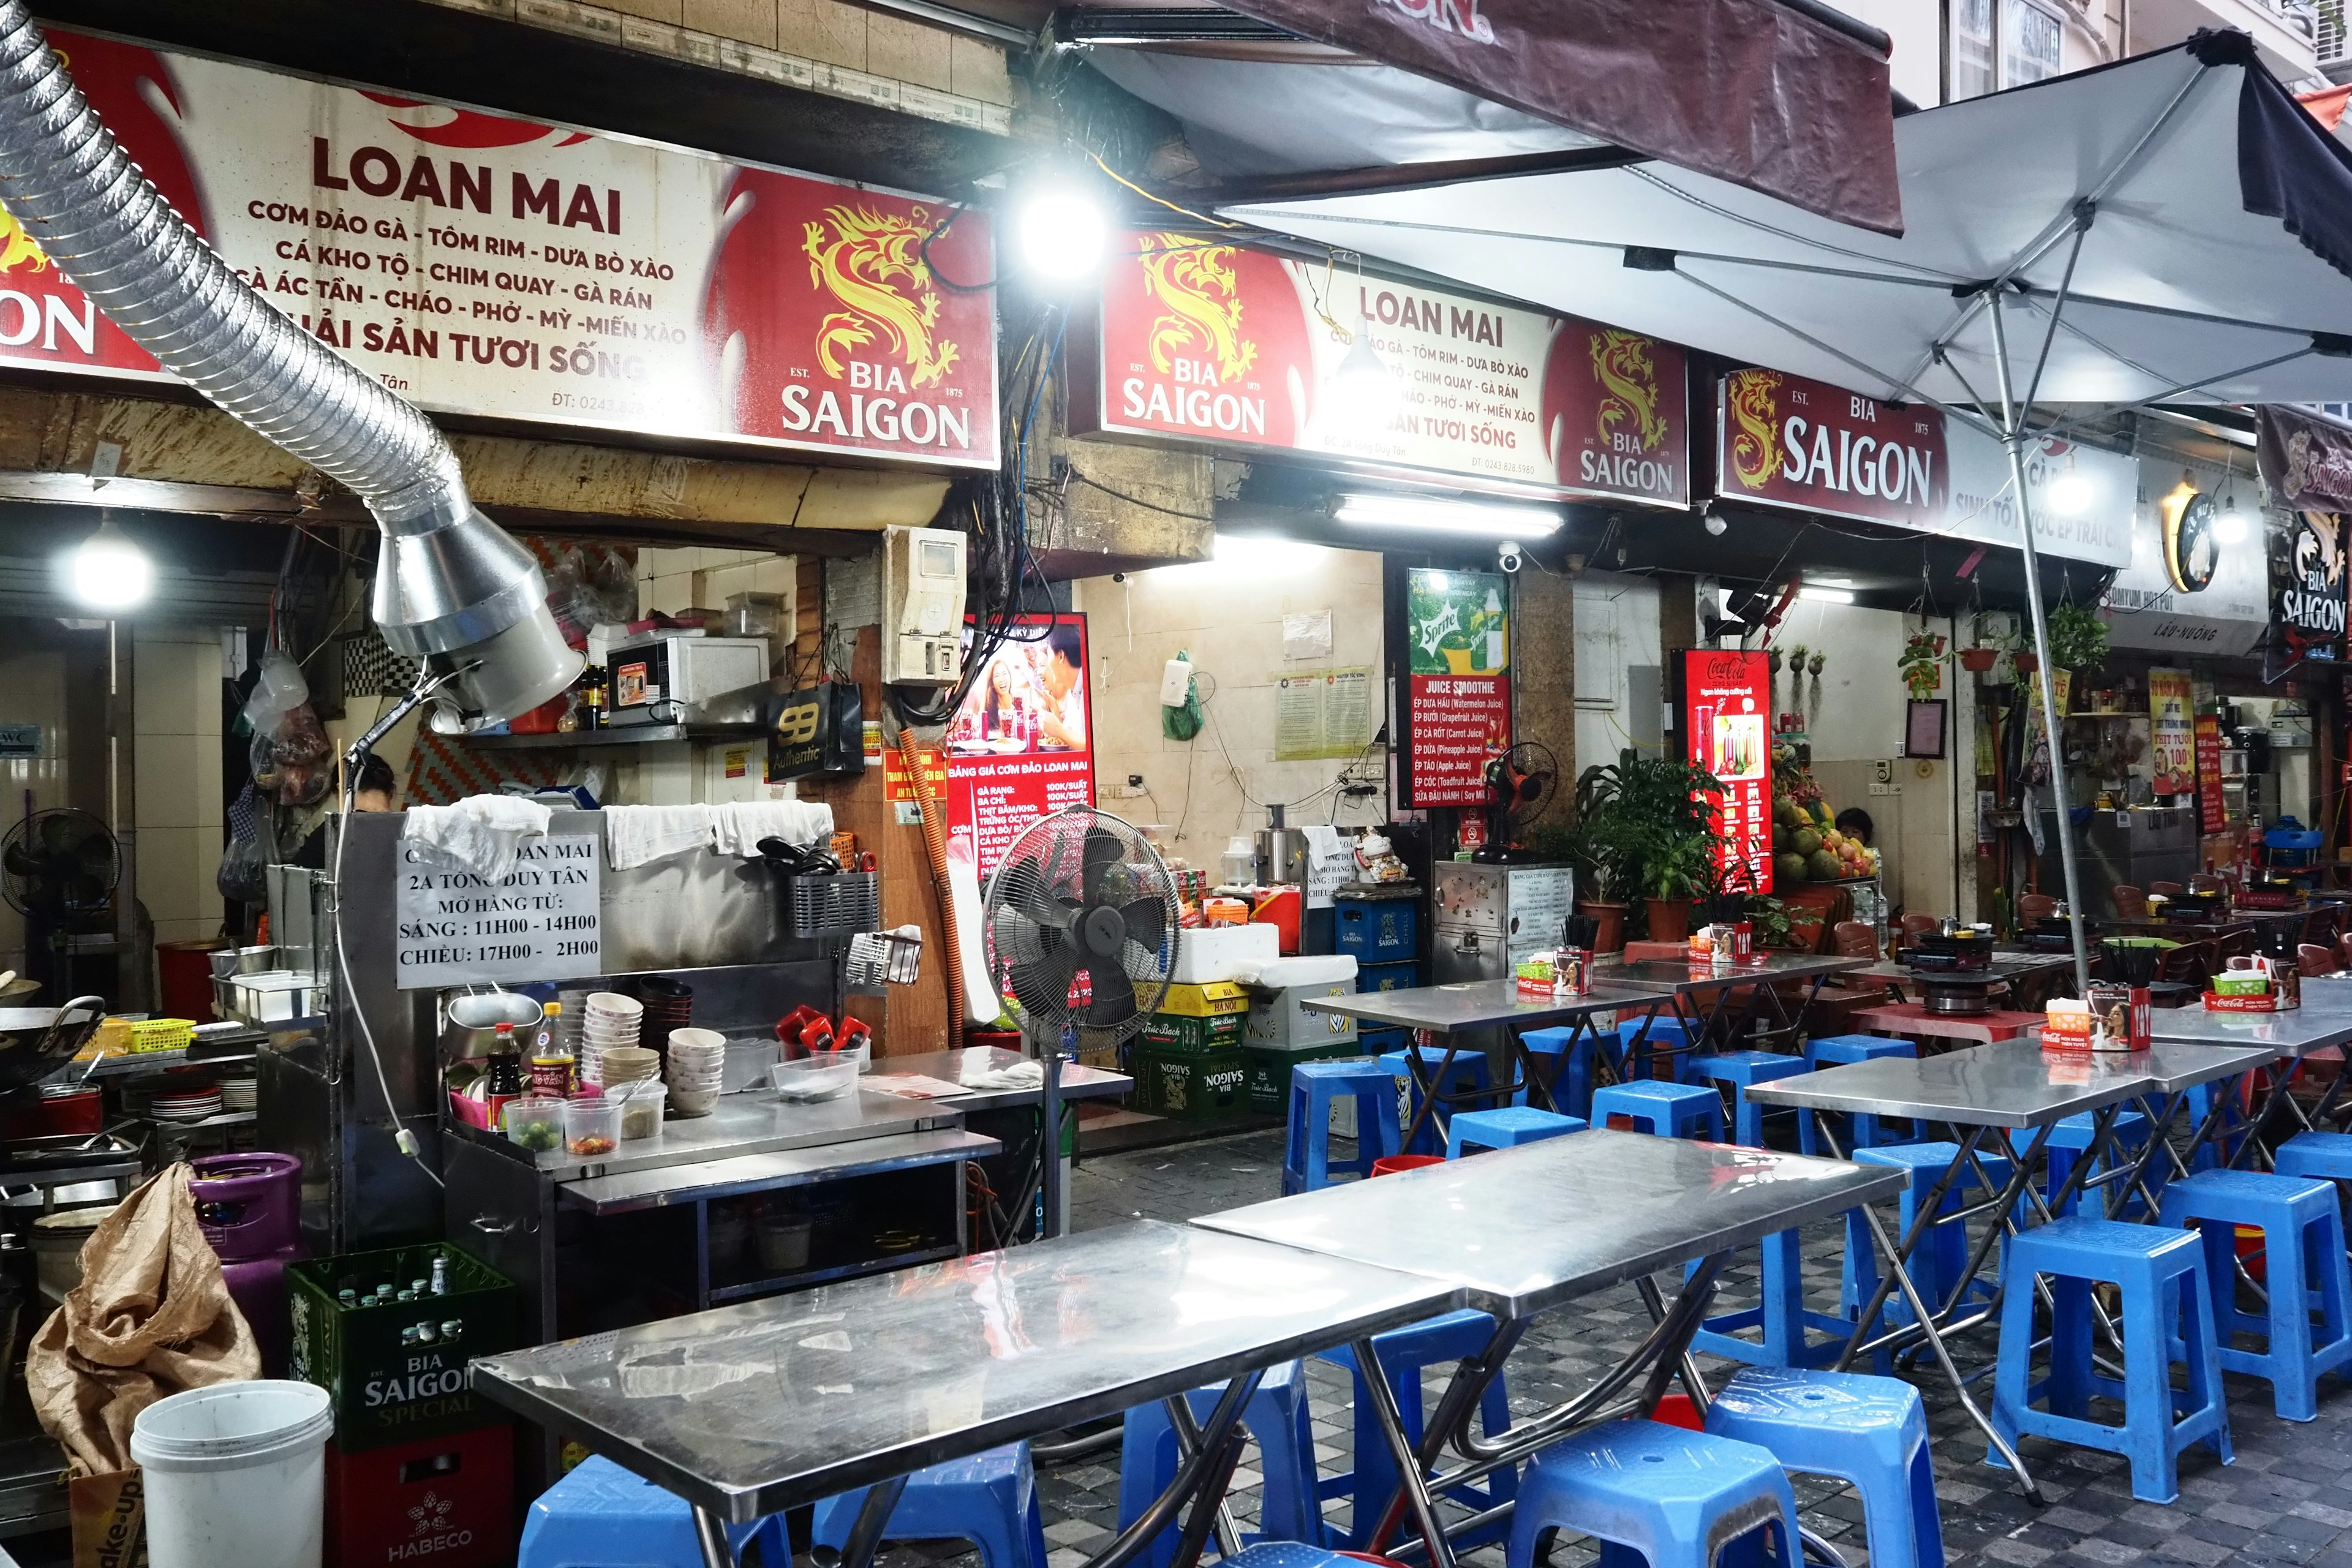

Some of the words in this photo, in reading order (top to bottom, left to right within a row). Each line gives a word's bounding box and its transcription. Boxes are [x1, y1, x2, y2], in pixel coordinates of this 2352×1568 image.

[314, 137, 492, 214] LOAN
[512, 173, 621, 235] MAI
[248, 200, 308, 226] CƠM
[315, 208, 367, 235] ĐẢO
[374, 216, 407, 241] GÀ
[428, 227, 478, 251] TÔM
[485, 238, 525, 258] RIM
[545, 246, 589, 268] DƯA
[595, 250, 624, 274] BÒ
[630, 257, 674, 281] XÀO
[276, 240, 311, 262] CÁ
[318, 246, 371, 270] KHO
[377, 252, 409, 282] TỘ
[430, 263, 488, 288] CHIM
[497, 272, 554, 296] QUAY
[574, 277, 605, 303] GÀ
[611, 284, 652, 311] RÁN
[274, 270, 309, 296] ÁC
[315, 277, 363, 303] TẦN
[385, 284, 453, 316] CHÁO
[472, 301, 521, 325] PHỞ
[540, 307, 571, 330] MỲ
[643, 322, 687, 345] XÀO
[1360, 286, 1441, 335] LOAN
[1451, 306, 1503, 348] MAI
[363, 317, 439, 360] SẢN
[449, 332, 539, 371] TƯƠI
[1388, 339, 1403, 355] GÀ
[1413, 344, 1436, 361] TÔM
[1439, 351, 1458, 365] RIM
[1467, 356, 1488, 371] DƯA
[1491, 359, 1505, 374] BÒ
[1507, 364, 1529, 379] XÀO
[790, 368, 810, 378] EST.
[850, 361, 907, 394] BIA
[946, 388, 962, 398] 1875
[1130, 363, 1145, 373] EST.
[1174, 358, 1218, 387] BIA
[1414, 370, 1441, 385] CHIM
[1444, 375, 1472, 391] QUAY
[1481, 381, 1496, 395] GÀ
[1498, 384, 1518, 399] RÁN
[782, 385, 970, 449] SAIGON
[1123, 378, 1265, 435] SAIGON
[1434, 394, 1457, 409] PHỞ
[1465, 400, 1480, 414] MỲ
[1514, 409, 1535, 423] XÀO
[1792, 391, 1808, 405] EST.
[1850, 396, 1876, 423] BIA
[1915, 422, 1929, 435] 1875
[1423, 416, 1466, 442] TƯƠI
[1471, 422, 1516, 449] SỐNG
[1614, 432, 1642, 455] BIA
[1485, 459, 1535, 475] 0243.828.5980
[1581, 450, 1673, 494] SAIGON
[1784, 415, 1932, 508] SAIGON
[1992, 496, 2013, 527] TỐ
[2308, 570, 2326, 592] BIA
[2144, 591, 2157, 609] HOT
[2160, 594, 2173, 611] POT
[2282, 589, 2346, 633] SAIGON
[1425, 614, 1455, 644] Sprite
[1426, 681, 1450, 693] JUICE
[1453, 681, 1495, 694] SMOOTHIE
[1414, 697, 1422, 707] ÉP
[1423, 699, 1436, 707] DƯA
[1438, 696, 1450, 707] HẤU
[1452, 699, 1486, 709] (Watermelon
[1487, 699, 1504, 709] Juice)
[1414, 710, 1422, 722] ÉP
[1440, 712, 1469, 723] (Grapefruit
[1471, 712, 1488, 723] Juice)
[1414, 726, 1422, 738] ÉP
[1423, 726, 1433, 737] CÀ
[1447, 728, 1466, 739] (Carrot
[1467, 729, 1484, 739] Juice)
[774, 744, 820, 770] Authentic
[1414, 744, 1422, 755] ÉP
[1438, 745, 1466, 756] (Pineapple
[1466, 745, 1482, 755] Juice)
[887, 772, 902, 782] THAM
[935, 771, 944, 781] GIA
[948, 764, 976, 778] BẢNG
[978, 763, 995, 777] GIÁ
[997, 764, 1020, 775] CƠM
[1022, 761, 1042, 774] ĐẢO
[1044, 763, 1069, 772] LOAN
[1071, 761, 1088, 771] MAI
[1415, 760, 1422, 771] ÉP
[1423, 760, 1435, 771] TÁO
[1436, 761, 1453, 772] (Apple
[1455, 761, 1471, 771] Juice)
[978, 786, 988, 796] GÀ
[989, 786, 1015, 795] RANG:
[1415, 775, 1422, 787] ÉP
[1424, 775, 1436, 786] CÓC
[1438, 777, 1464, 788] (Toadfruit
[1466, 777, 1482, 787] Juice)
[897, 788, 905, 798] AN
[1442, 790, 1460, 801] NÀNH
[1464, 791, 1474, 802] Soy
[978, 807, 997, 818] THỊT
[979, 816, 1006, 826] TRỨNG
[951, 825, 971, 834] CƠM
[979, 826, 997, 836] DƯA
[555, 844, 592, 859] MAI
[980, 837, 990, 846] CÁ
[992, 836, 1009, 845] KHO
[980, 847, 997, 856] TIM
[981, 856, 998, 865] TÔM
[1332, 864, 1349, 873] HÀNG
[410, 875, 433, 890] 2A
[504, 871, 544, 886] DUY
[549, 867, 588, 884] TÂN
[438, 895, 470, 914] MỞ
[475, 895, 527, 913] HÀNG
[532, 892, 564, 910] TỪ:
[400, 919, 456, 939] SÁNG
[475, 919, 527, 935] 11H00
[545, 915, 597, 932] 14H00
[400, 944, 472, 965] CHIỀU:
[479, 944, 530, 961] 17H00
[556, 940, 598, 956] 2H00
[1161, 1063, 1189, 1075] SAIGON
[1205, 1070, 1243, 1087] SAIGON
[408, 1354, 442, 1373] BIA
[378, 1394, 475, 1427] SPECIAL
[388, 1530, 472, 1562] HABECO
